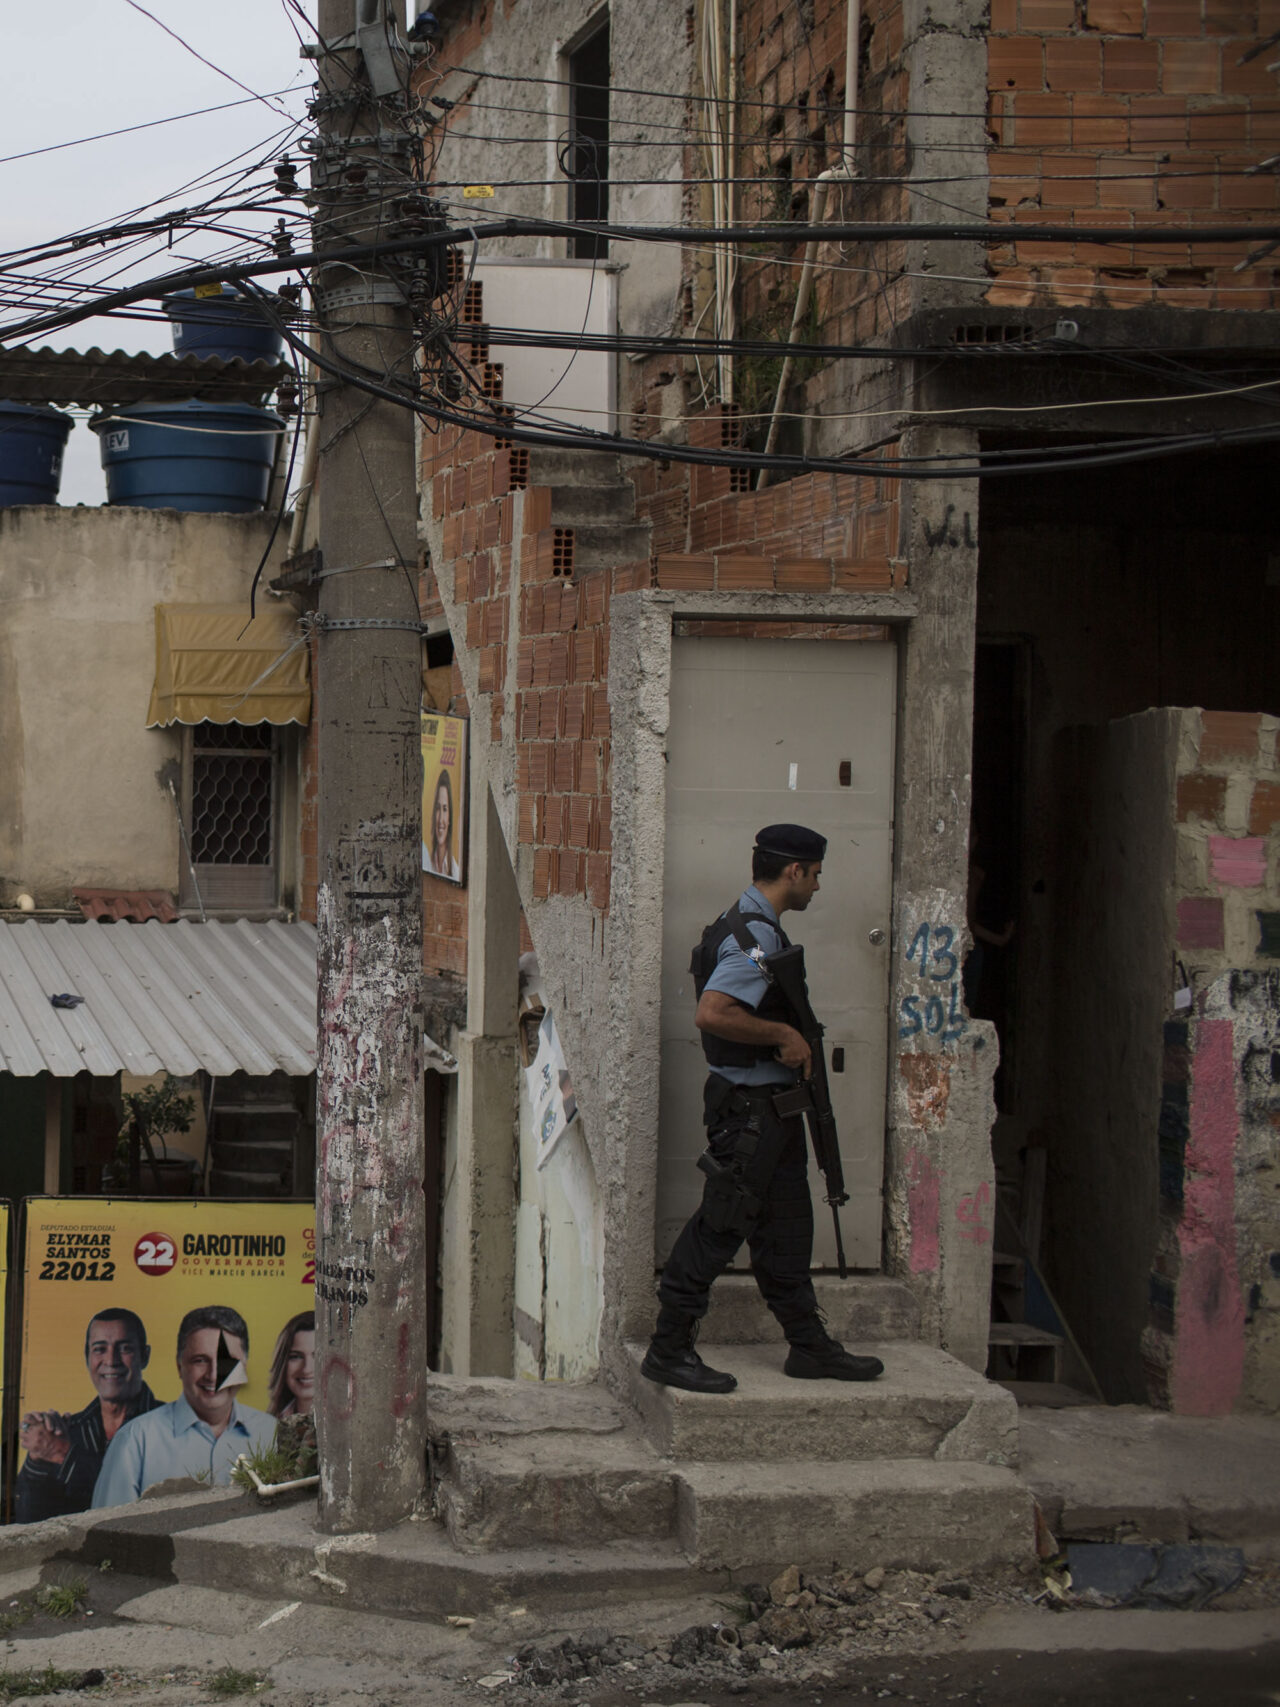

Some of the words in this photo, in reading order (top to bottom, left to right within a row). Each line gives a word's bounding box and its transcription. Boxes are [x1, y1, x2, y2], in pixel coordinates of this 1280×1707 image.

[46, 1233, 111, 1246] ELYMAR
[183, 1233, 286, 1257] GAROTINHO
[46, 1246, 111, 1259] SANTOS
[137, 1241, 174, 1266] 22
[39, 1260, 116, 1281] 22012
[182, 1258, 285, 1266] GOVERNADOR
